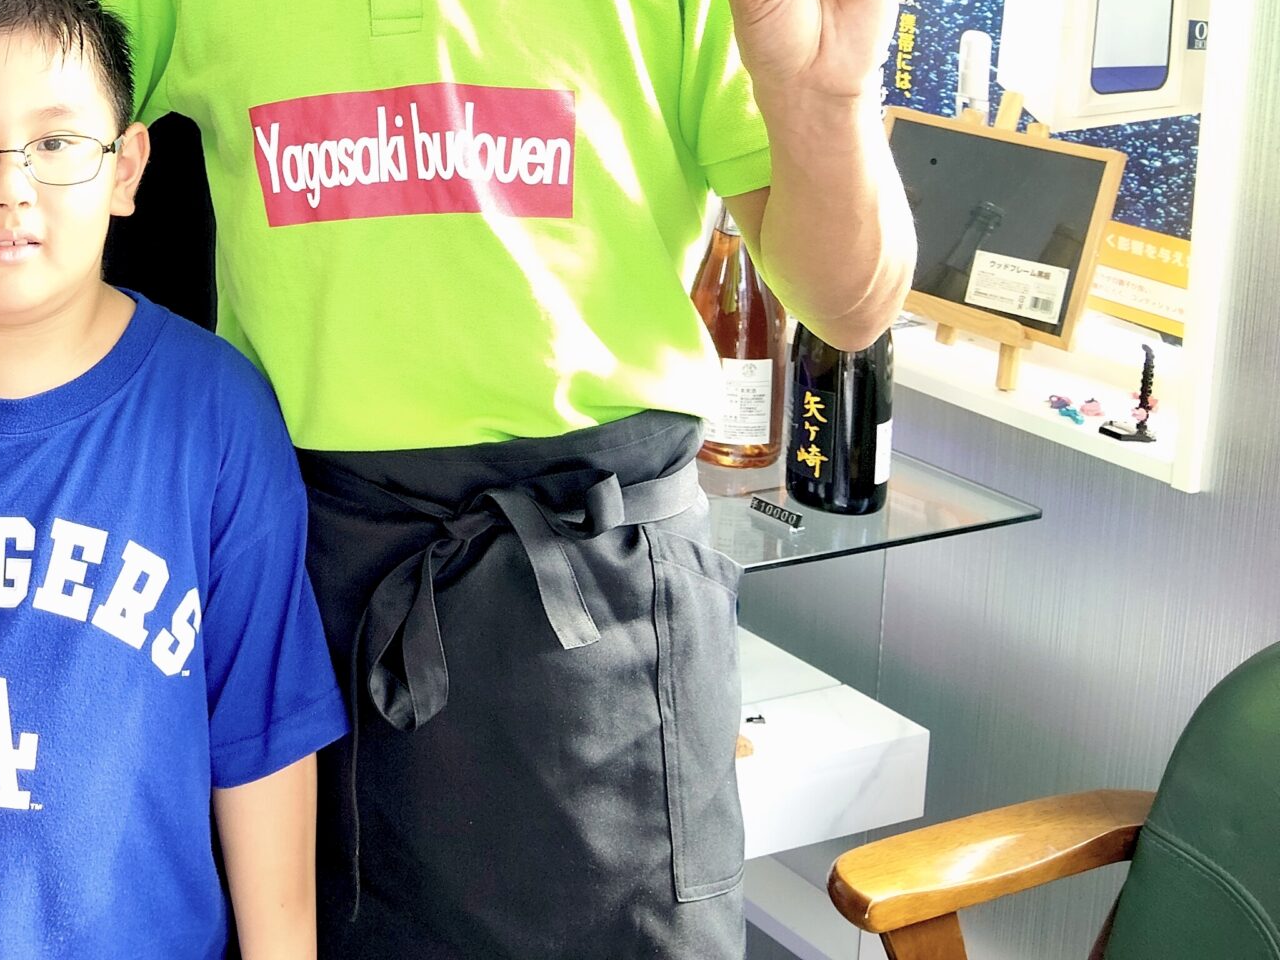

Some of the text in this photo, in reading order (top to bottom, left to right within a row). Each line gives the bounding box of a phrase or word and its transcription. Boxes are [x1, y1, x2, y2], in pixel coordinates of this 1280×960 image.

[895, 13, 917, 99] 携帯には、
[254, 101, 571, 208] Yagasaki budouen
